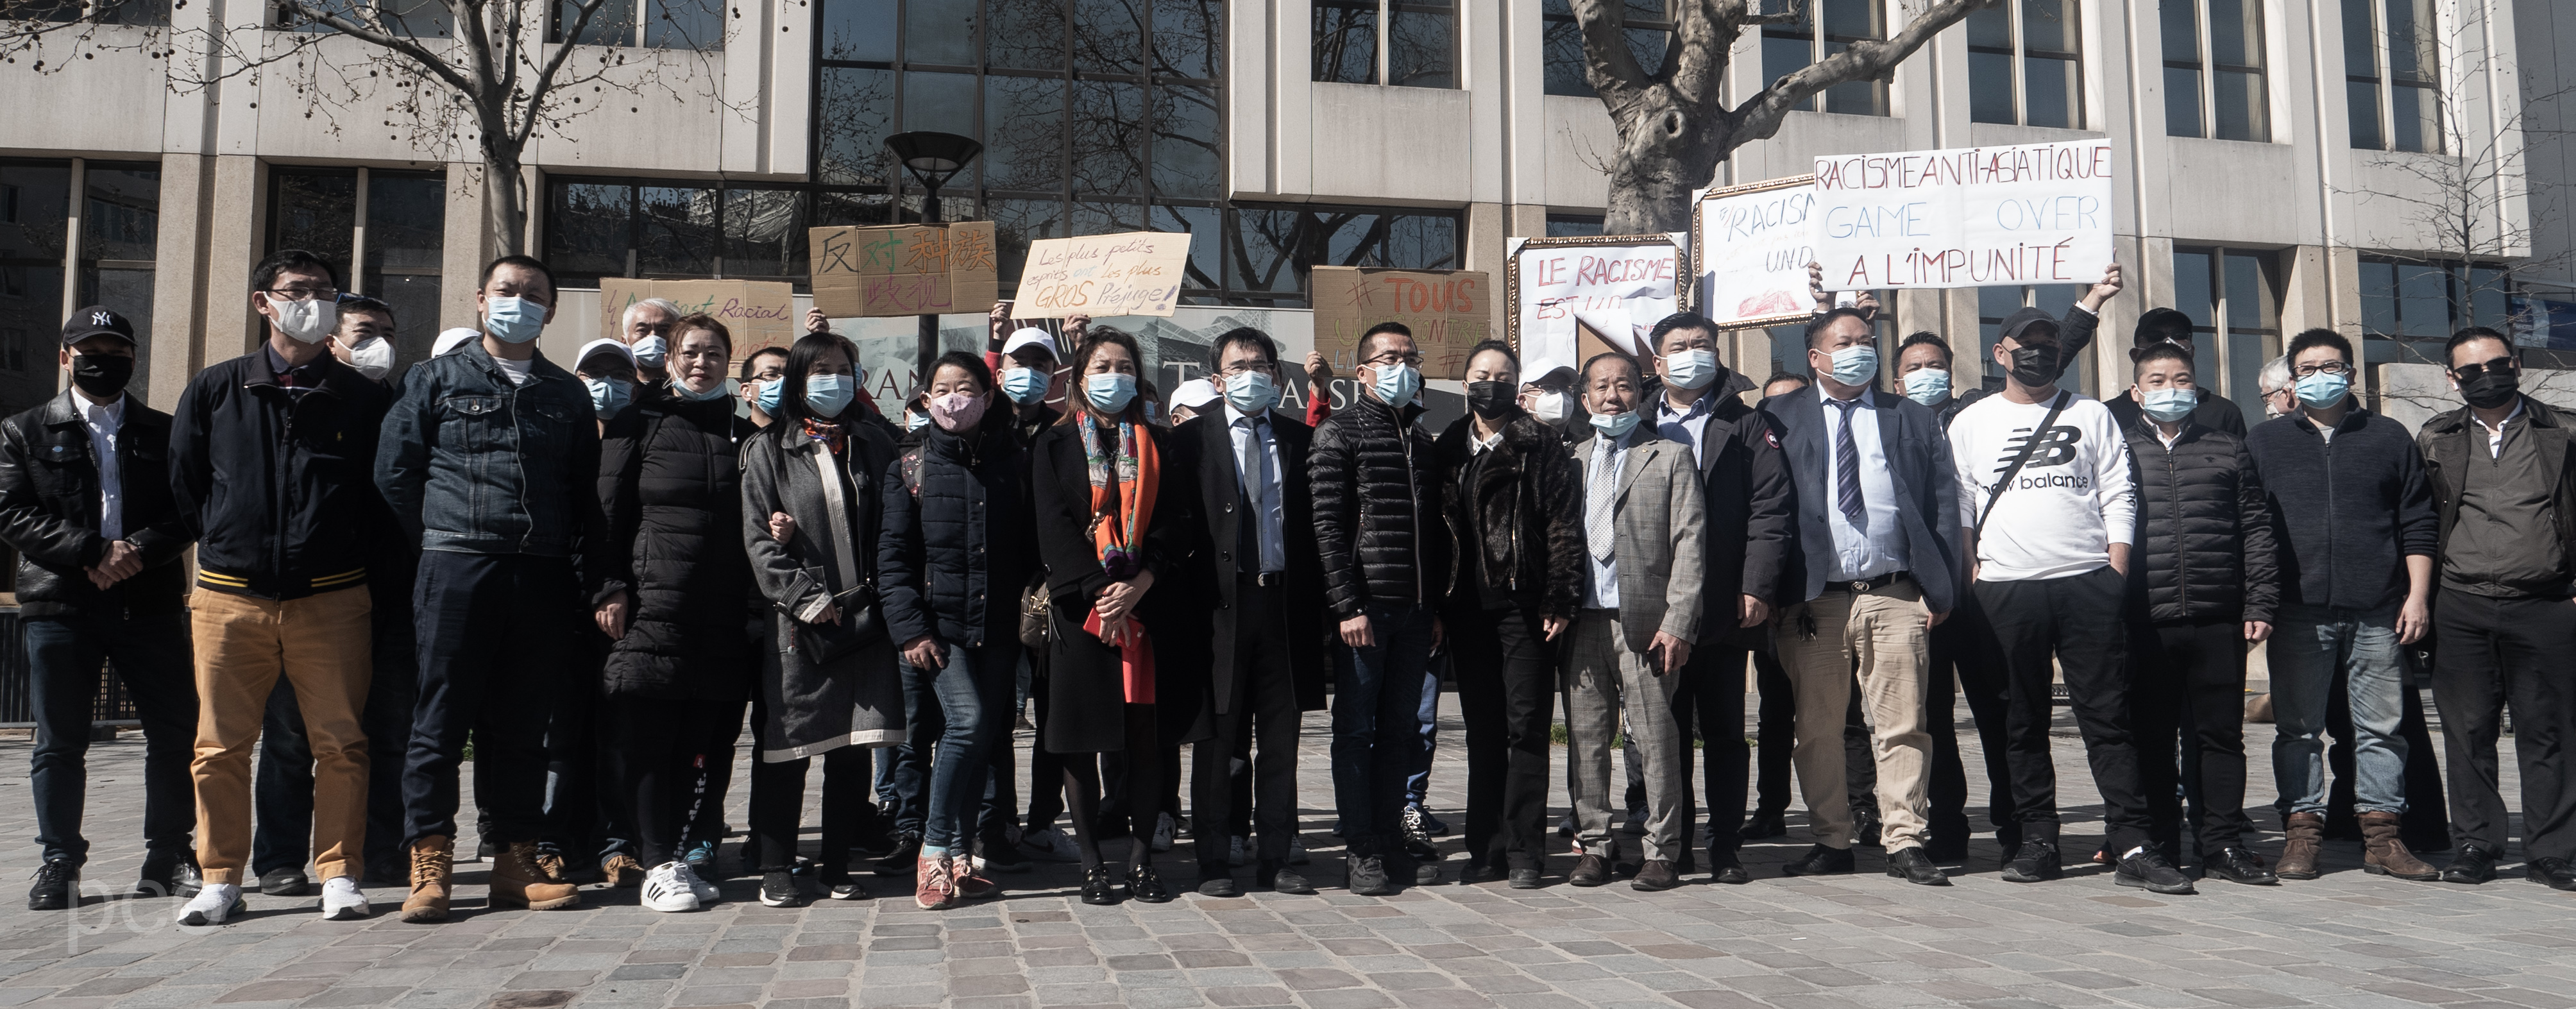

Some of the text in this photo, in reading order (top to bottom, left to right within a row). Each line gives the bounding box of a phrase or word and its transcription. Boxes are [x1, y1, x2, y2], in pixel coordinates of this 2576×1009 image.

[1815, 155, 1921, 191] RACISME
[1826, 195, 2099, 239] GAME OVER
[817, 229, 996, 277] 反对种族
[1038, 238, 1155, 267] Les plus petits
[1026, 269, 1068, 291] esprits
[1073, 266, 1098, 278] ont
[1124, 259, 1162, 284] plus
[1538, 255, 1674, 287] LE RACISME
[1847, 255, 1870, 285] A
[867, 273, 952, 311] 歧视
[1035, 280, 1094, 309] GROS
[1537, 295, 1579, 319] EST
[718, 298, 789, 321] Racial
[2020, 472, 2089, 490] balance
